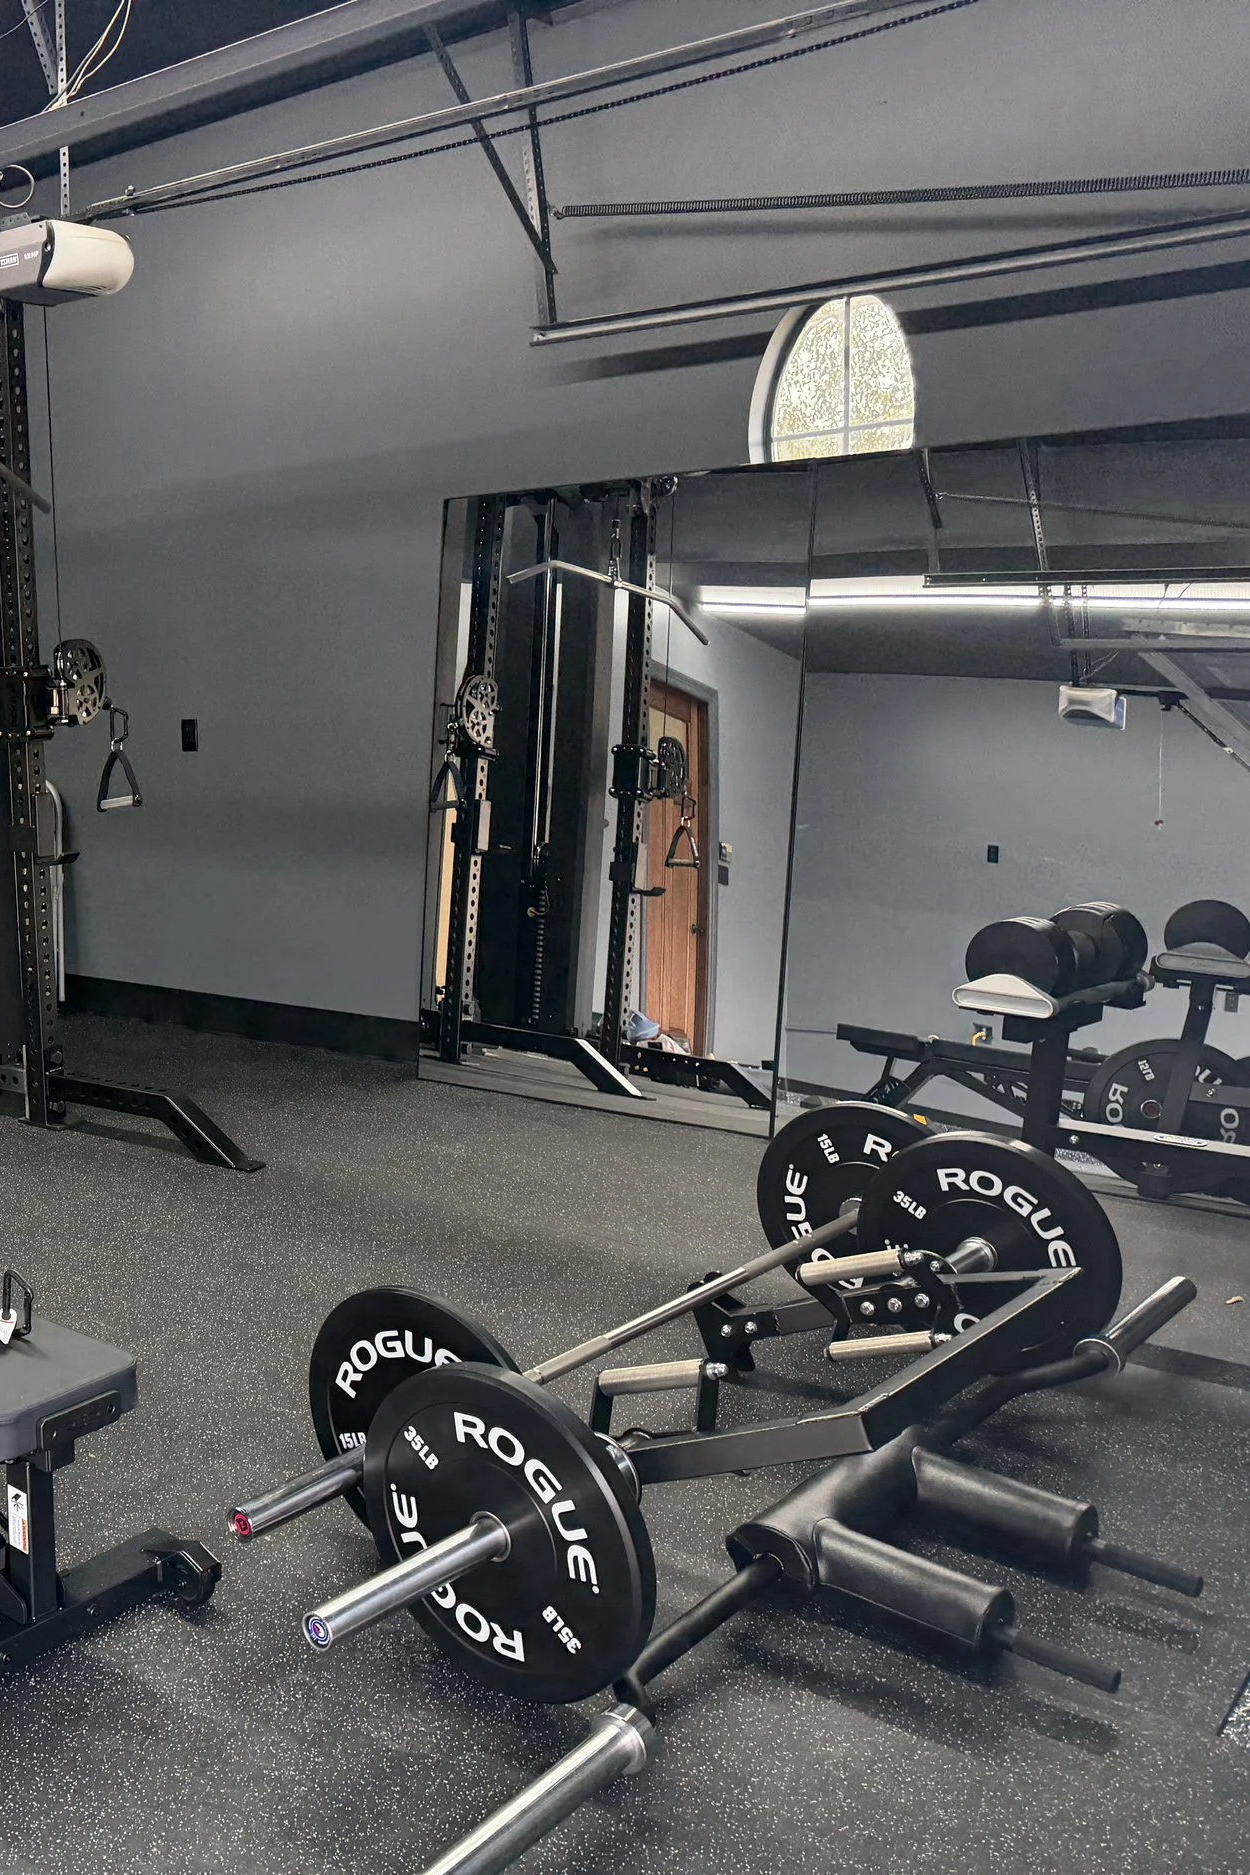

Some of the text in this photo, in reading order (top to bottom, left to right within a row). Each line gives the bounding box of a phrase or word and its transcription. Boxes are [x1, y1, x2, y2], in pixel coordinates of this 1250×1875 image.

[817, 1133, 840, 1164] 15LB
[892, 1190, 927, 1221] 35LB
[936, 1167, 1077, 1267] ROGUE
[403, 1425, 439, 1471] 35LB
[453, 1411, 598, 1588] ROGUE
[541, 1605, 582, 1655] 35LB
